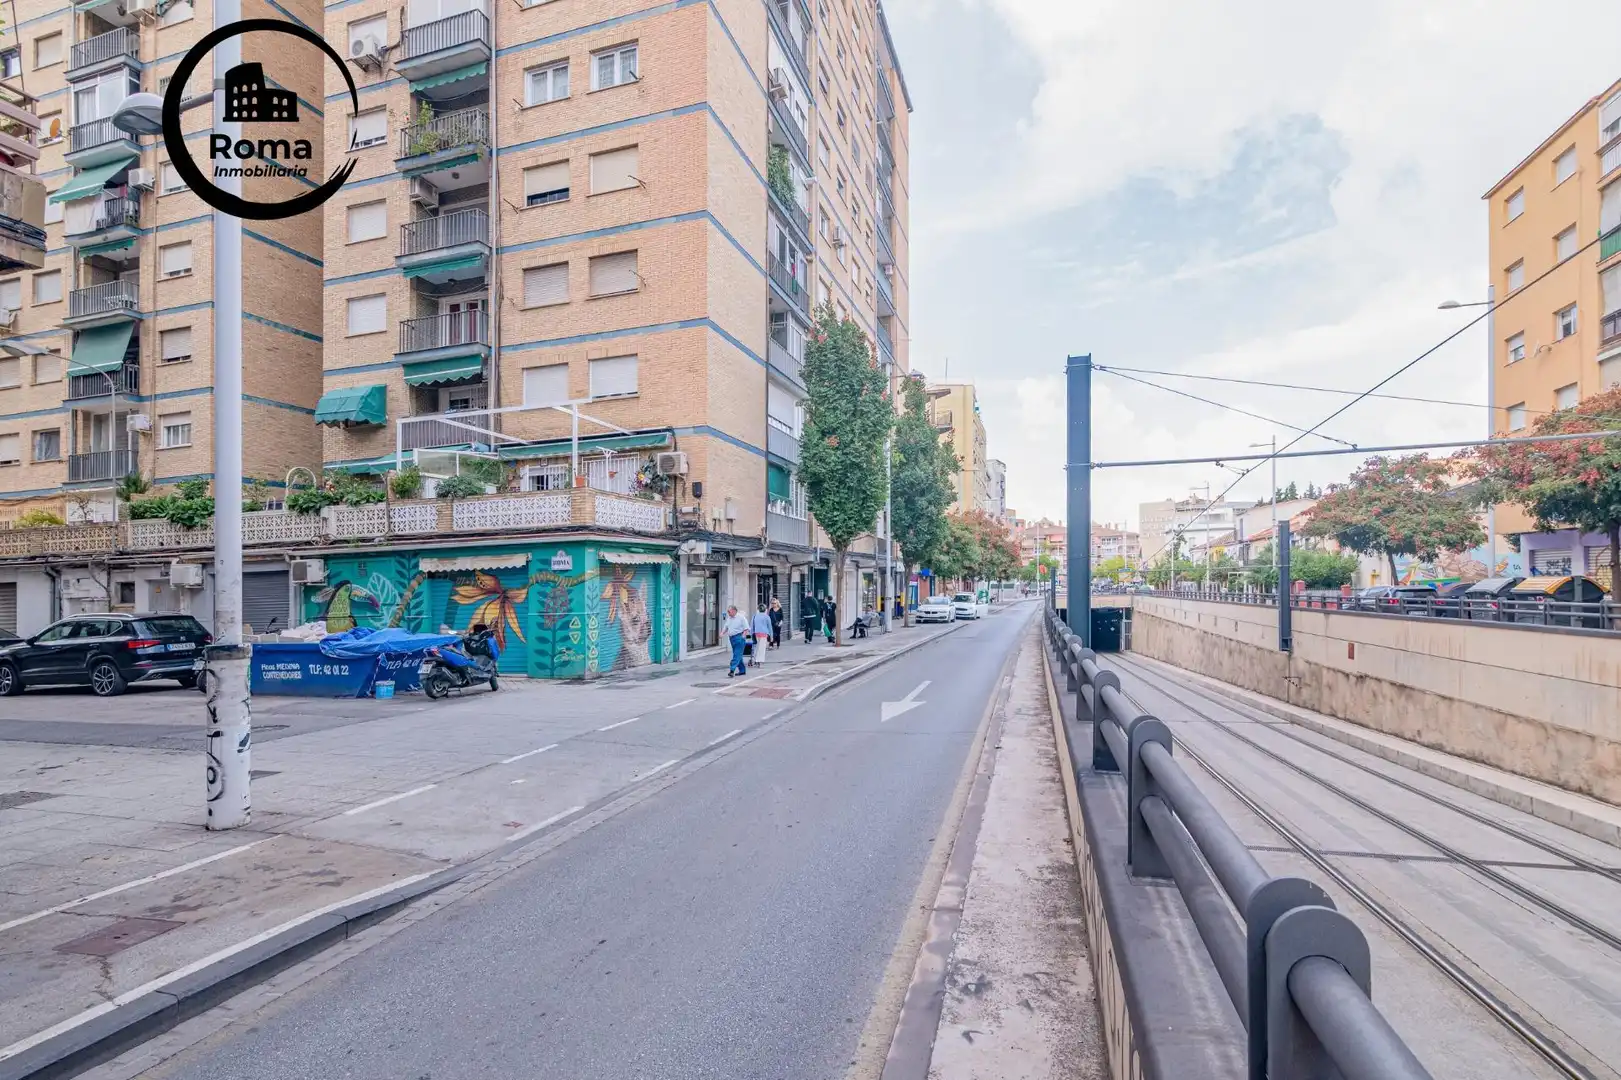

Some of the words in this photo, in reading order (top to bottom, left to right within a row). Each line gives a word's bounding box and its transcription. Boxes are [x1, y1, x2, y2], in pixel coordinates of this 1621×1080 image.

[276, 662, 300, 671] MEDINA
[323, 665, 332, 675] 42
[340, 665, 349, 675] 22
[262, 671, 302, 680] CONTENEDORES
